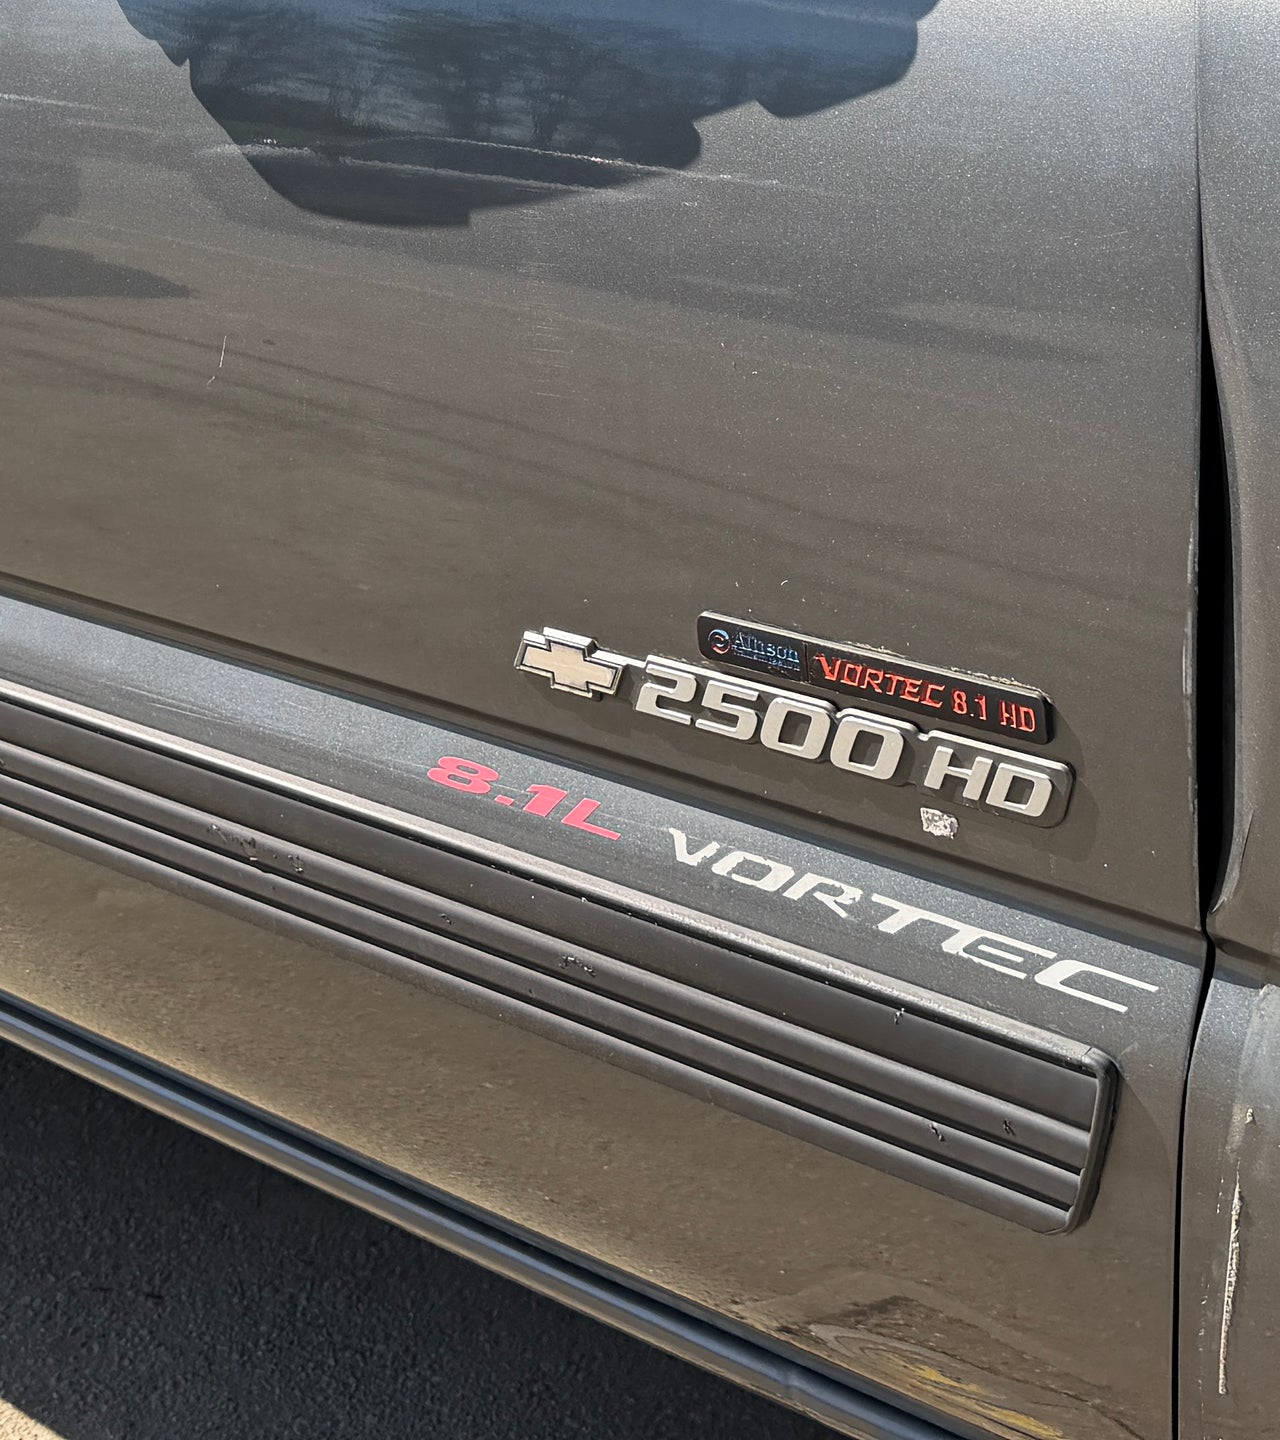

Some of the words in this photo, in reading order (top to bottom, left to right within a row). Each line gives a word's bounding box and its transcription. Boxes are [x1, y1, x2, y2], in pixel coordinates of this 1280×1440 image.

[634, 664, 907, 782] 2500
[923, 745, 1053, 818] HD
[813, 653, 946, 709] VORTEC
[951, 689, 988, 721] 8.1
[999, 700, 1038, 734] HD
[427, 754, 621, 841] 8.1L
[666, 827, 1160, 1012] VORTEC
